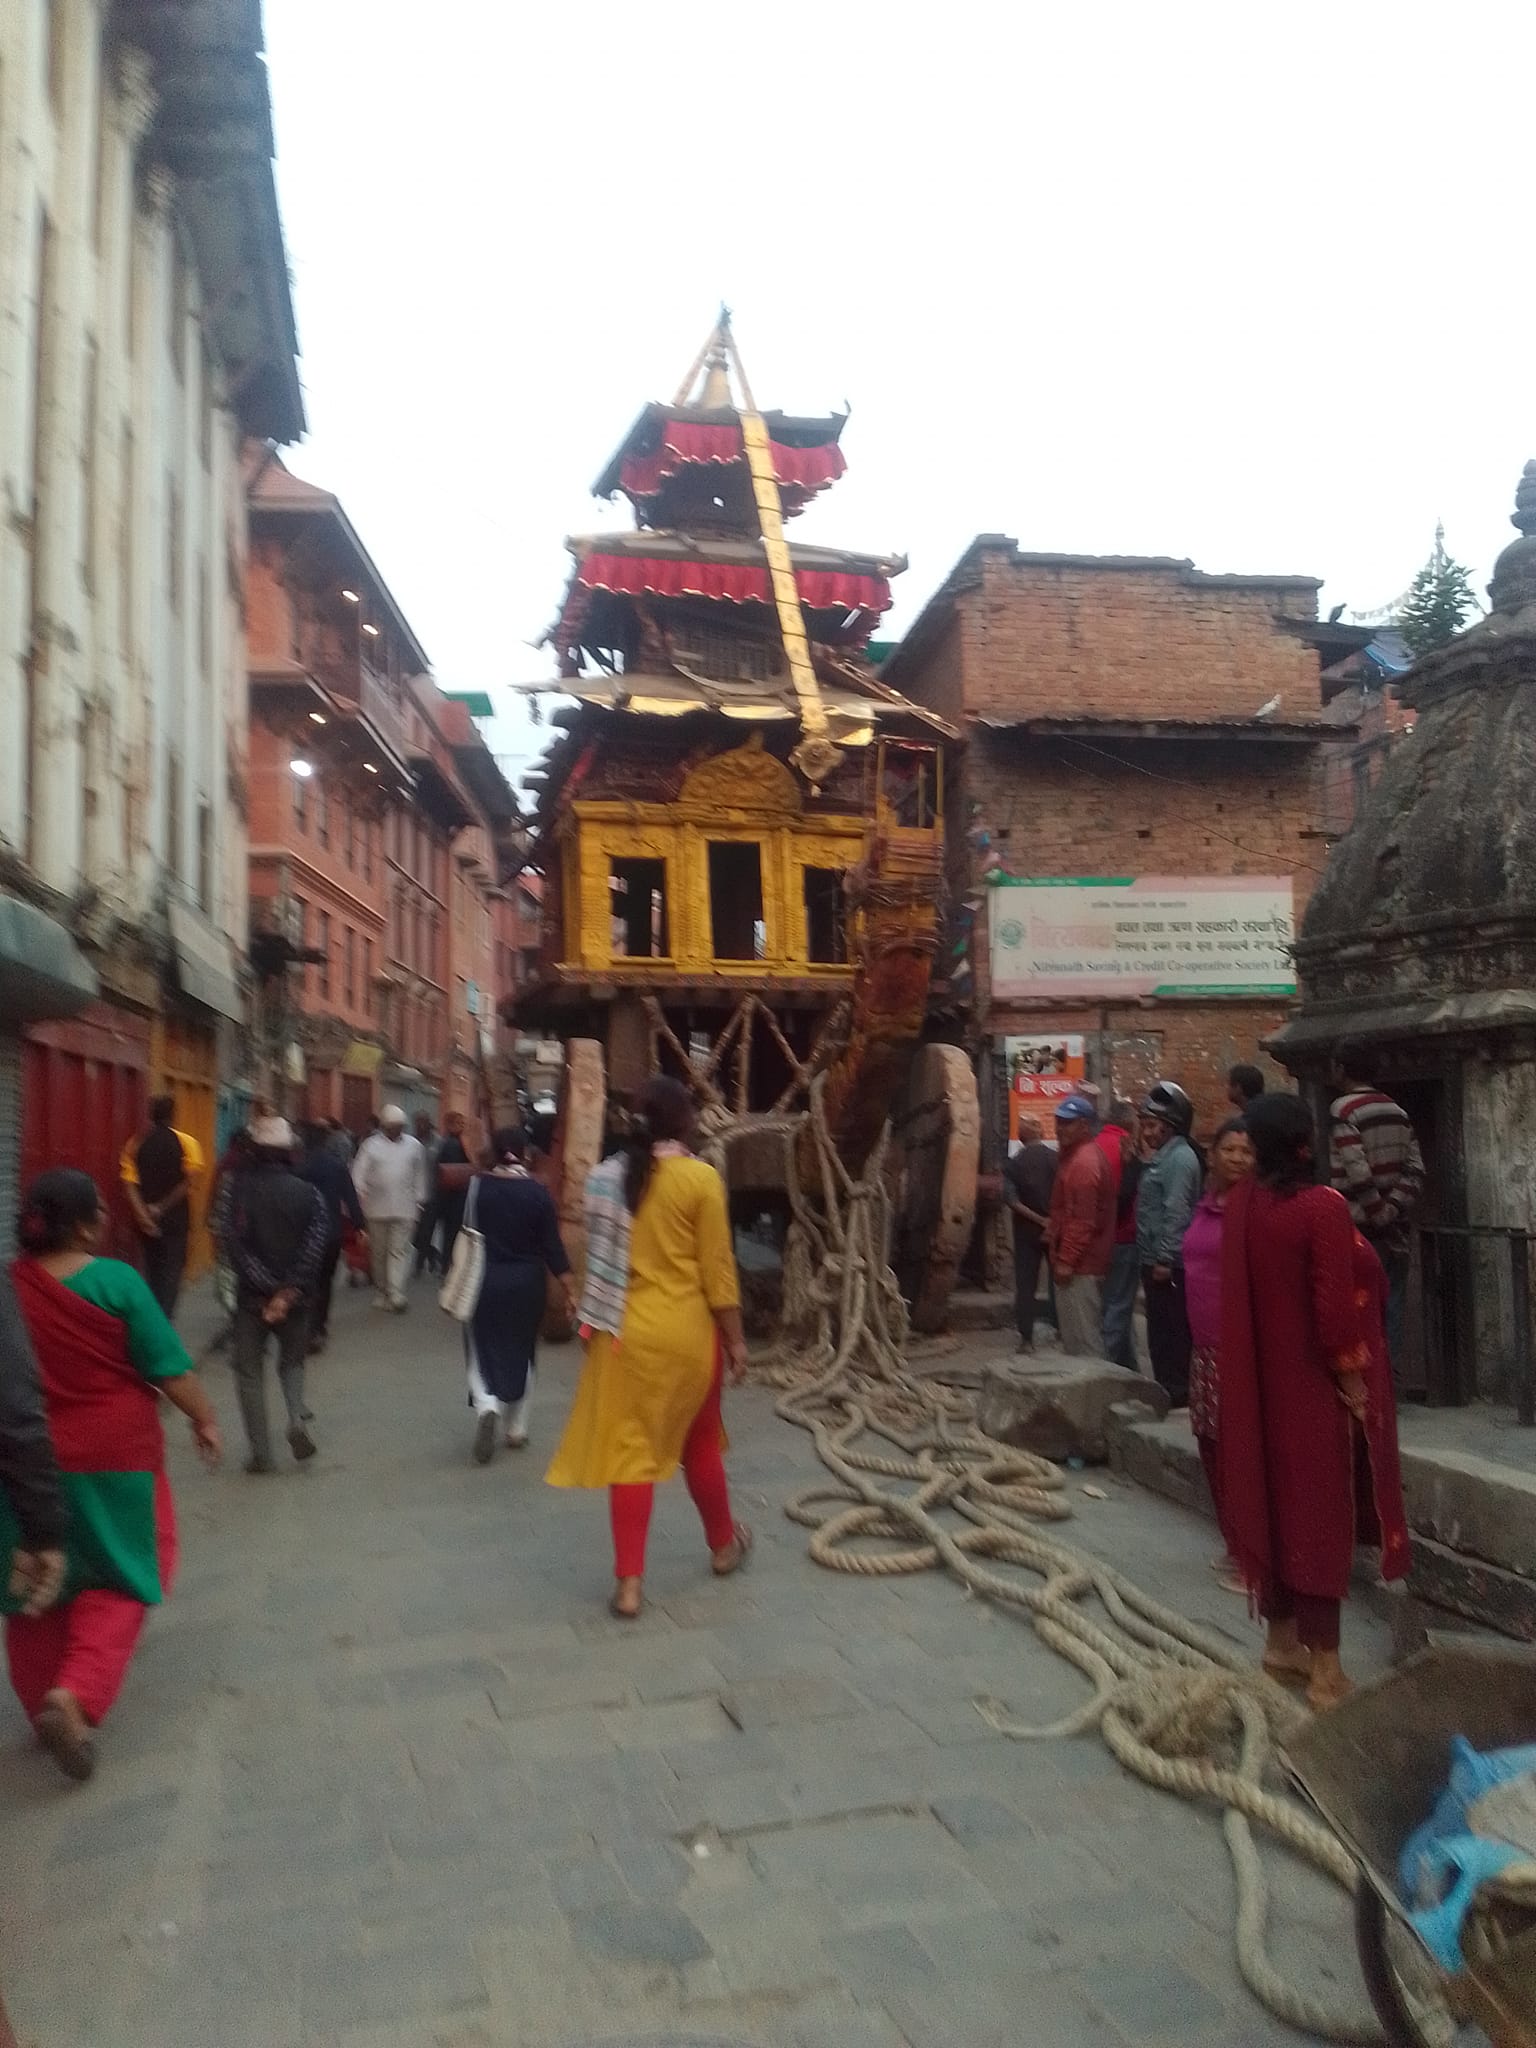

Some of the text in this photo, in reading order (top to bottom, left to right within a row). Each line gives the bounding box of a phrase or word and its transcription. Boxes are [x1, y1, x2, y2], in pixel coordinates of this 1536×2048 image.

[1196, 918, 1238, 933] सहकारी
[1134, 960, 1165, 972] Credit
[1167, 959, 1232, 974] Co-operative
[1234, 959, 1270, 973] Society
